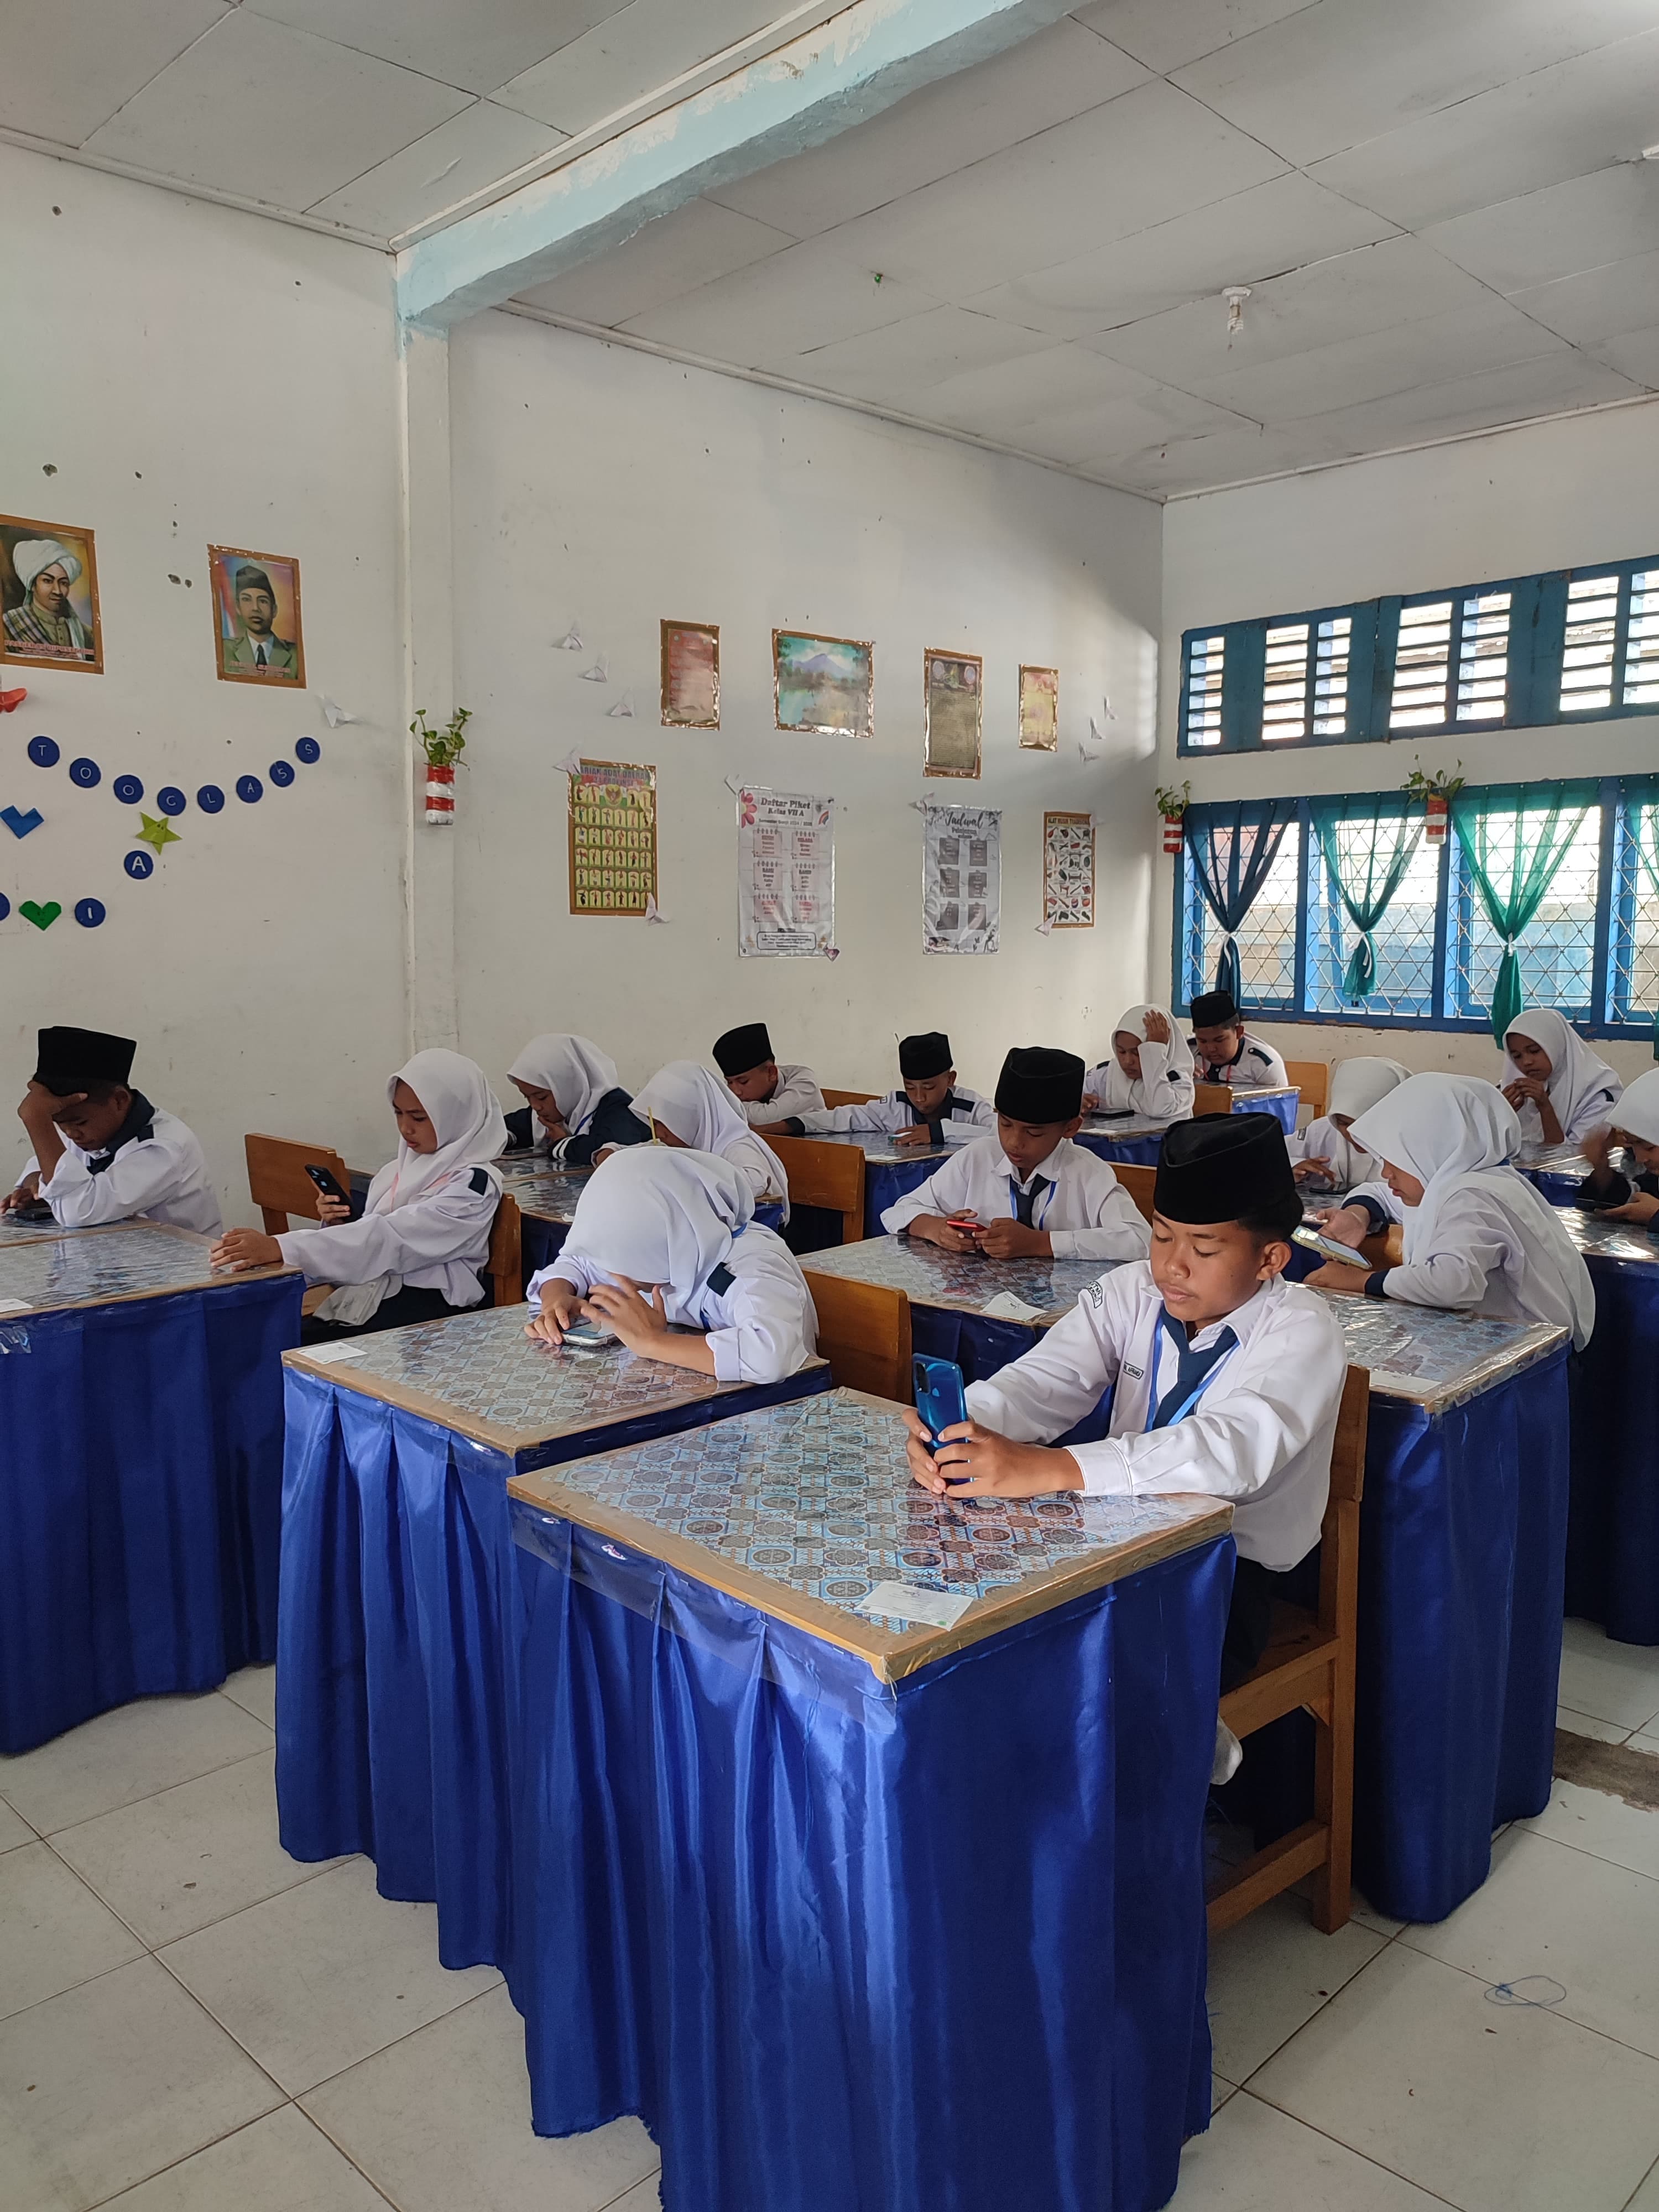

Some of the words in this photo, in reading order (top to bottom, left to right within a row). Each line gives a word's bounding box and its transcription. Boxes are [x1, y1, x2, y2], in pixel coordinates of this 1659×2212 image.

[761, 797, 787, 807] Daftar
[790, 800, 811, 809] Piket
[945, 811, 984, 830] Jadwal
[132, 855, 147, 872] A
